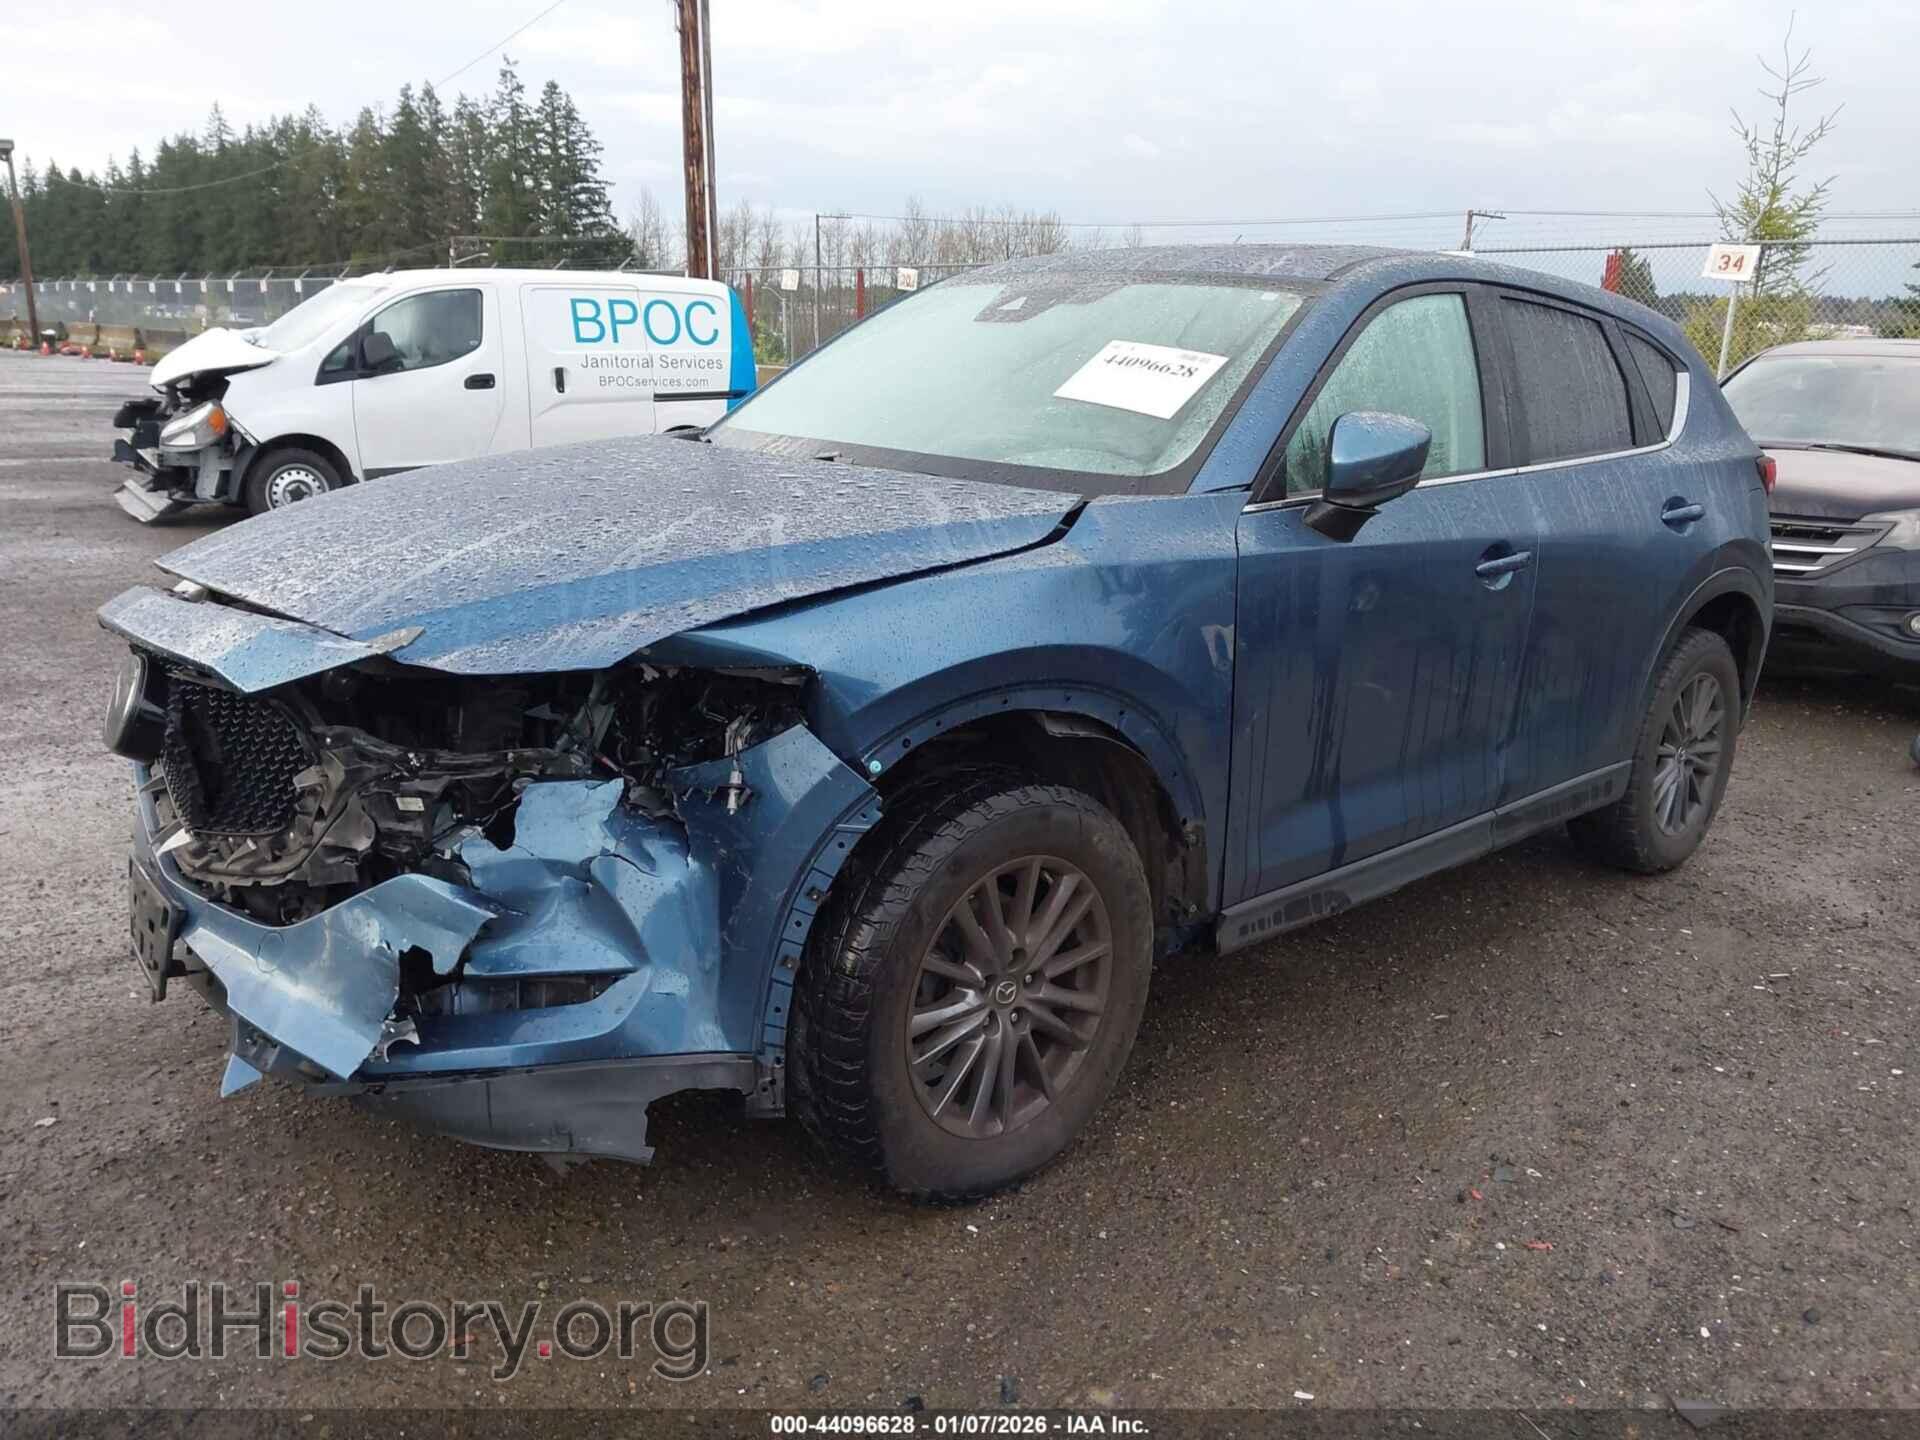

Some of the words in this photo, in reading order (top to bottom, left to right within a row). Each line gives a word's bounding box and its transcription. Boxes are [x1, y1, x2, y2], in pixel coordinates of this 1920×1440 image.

[1718, 254, 1745, 272] 34
[570, 297, 719, 346] BPOC
[580, 353, 655, 369] Janitorial
[659, 354, 724, 370] Services
[1103, 353, 1200, 379] 44096628
[599, 375, 710, 388] BPOCservices.com
